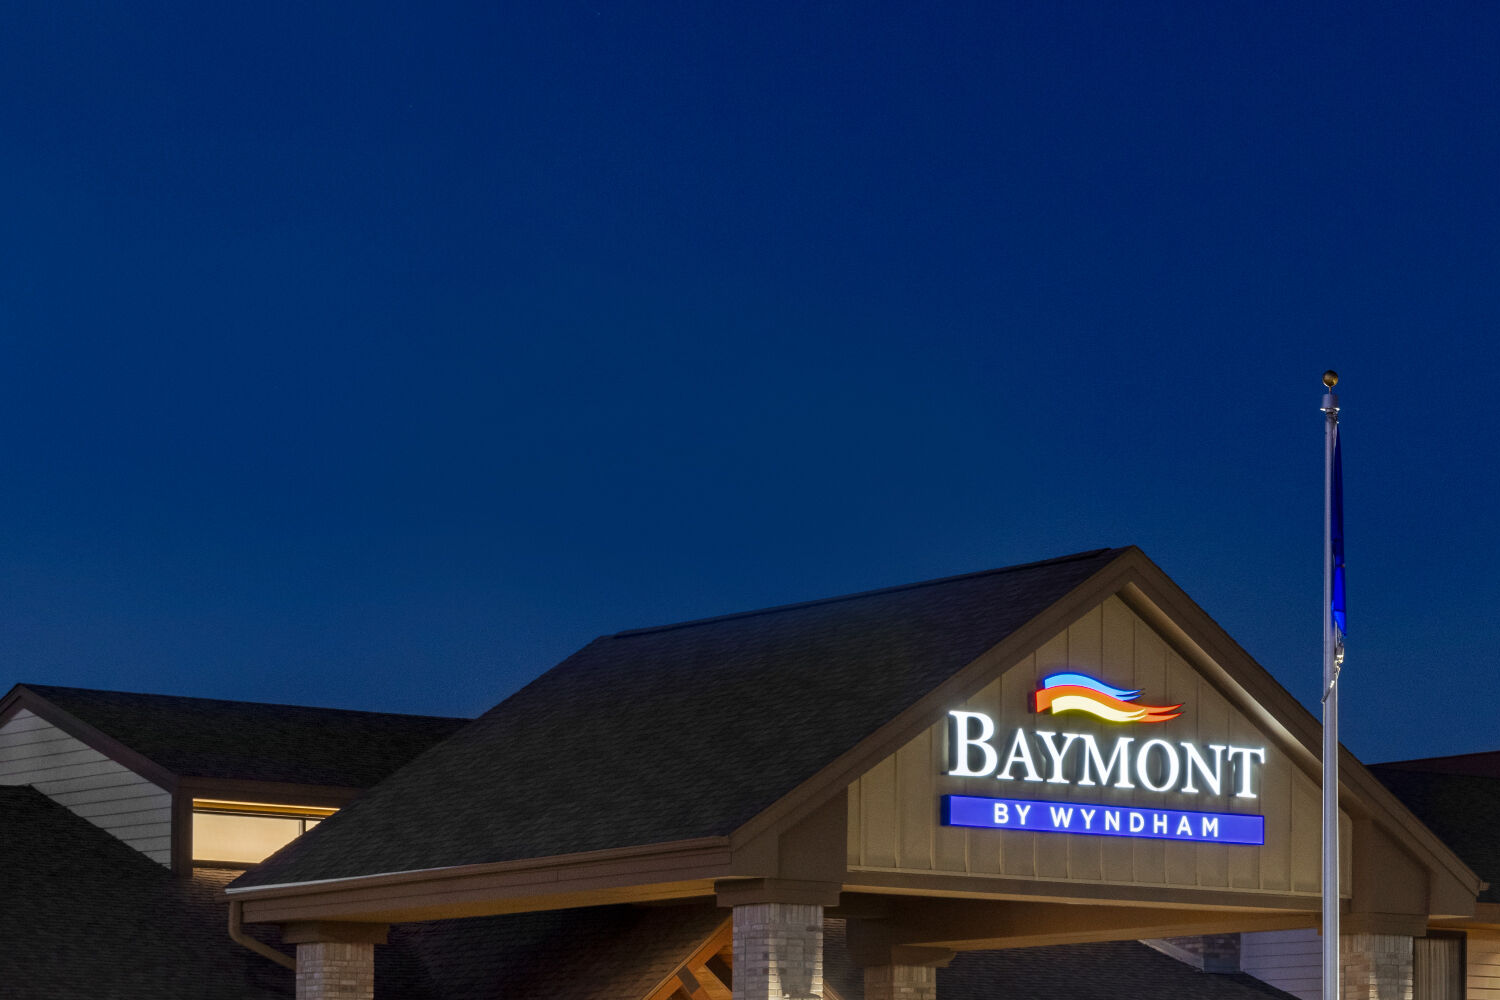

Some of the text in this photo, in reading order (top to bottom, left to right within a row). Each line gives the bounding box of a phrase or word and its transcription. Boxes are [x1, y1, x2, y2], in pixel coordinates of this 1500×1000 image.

[948, 710, 1265, 799] BAYMONT
[993, 802, 1219, 838] BY WYNDHAM
